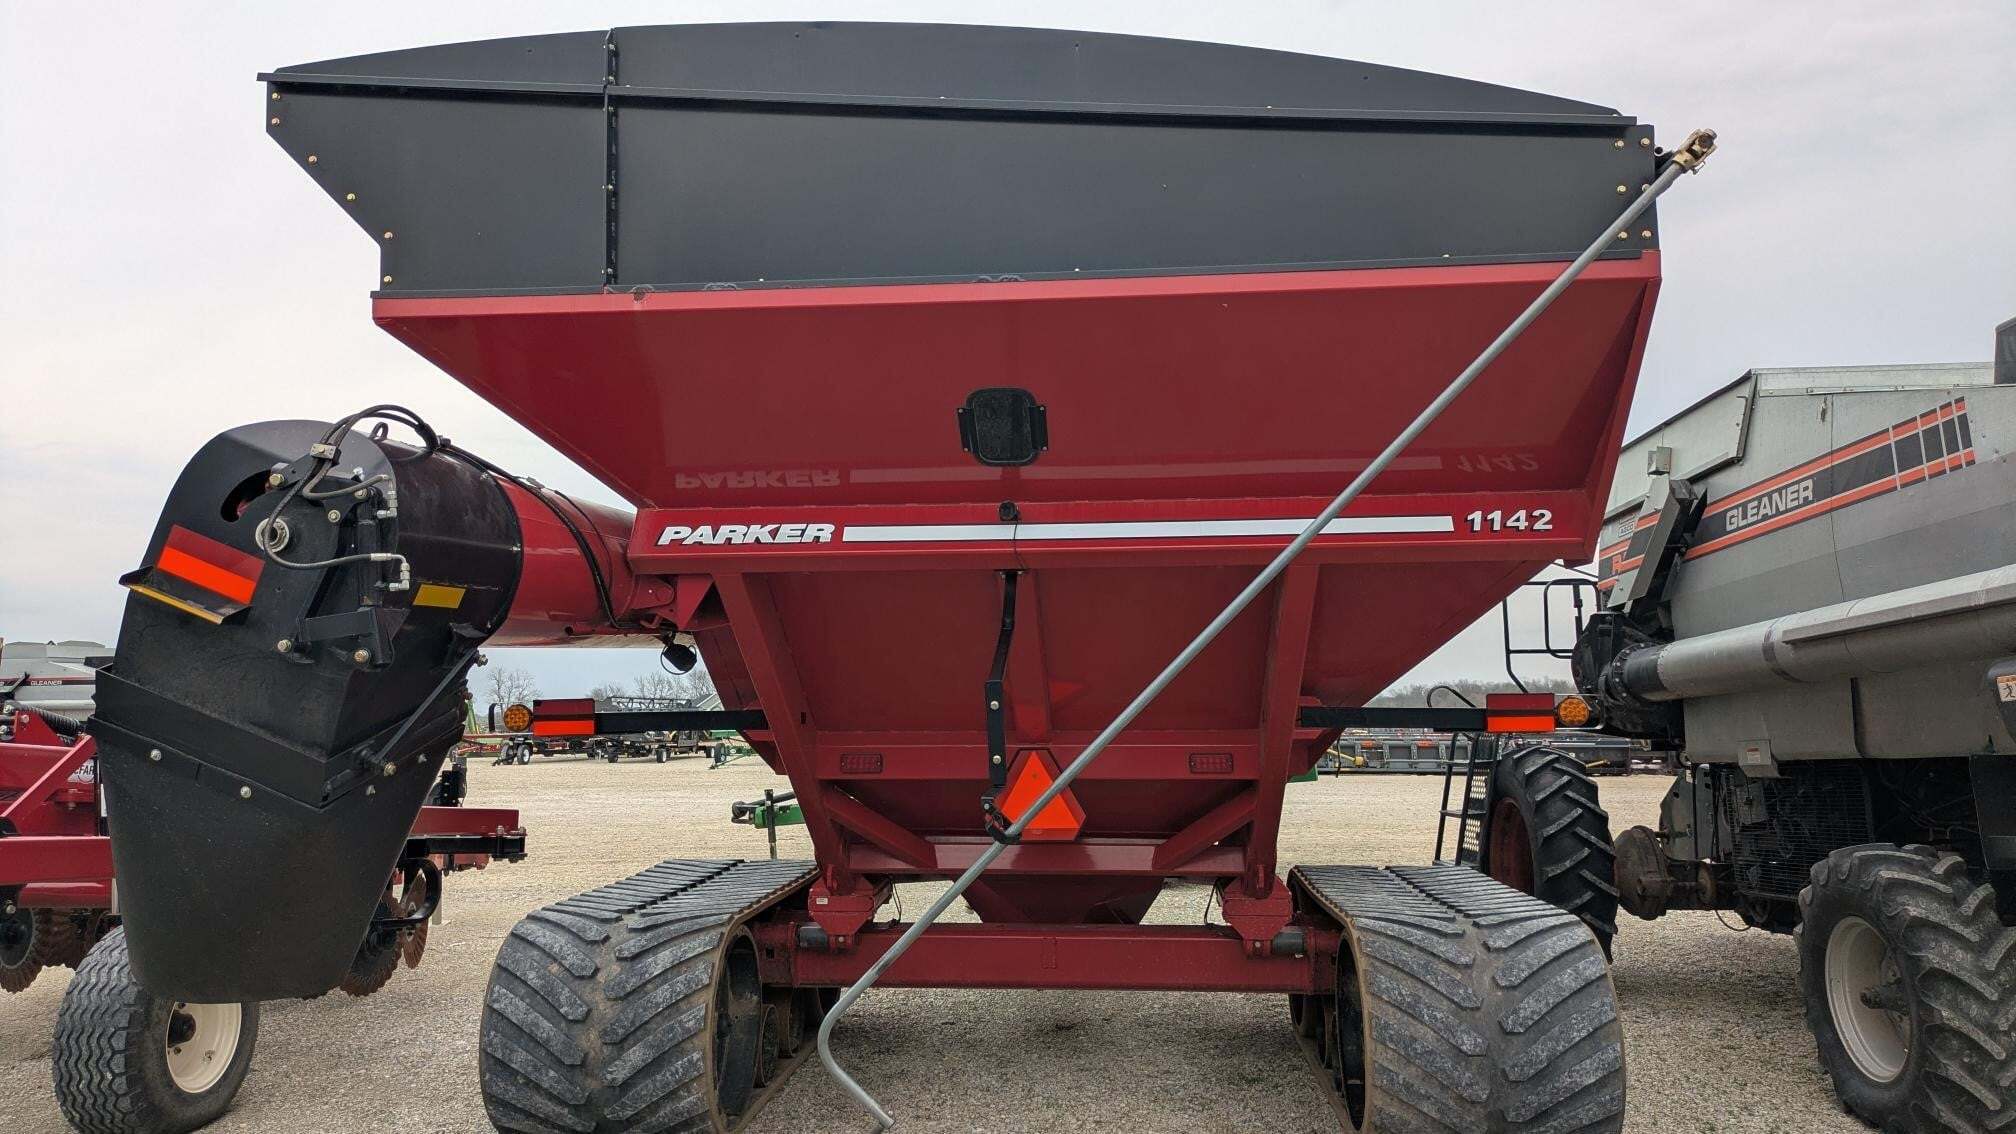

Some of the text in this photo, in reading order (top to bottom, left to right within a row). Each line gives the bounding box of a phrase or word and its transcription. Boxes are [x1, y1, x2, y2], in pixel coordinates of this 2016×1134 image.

[1725, 479, 1814, 531] GLEANER
[1466, 509, 1553, 531] 1142
[656, 523, 836, 546] PARKER
